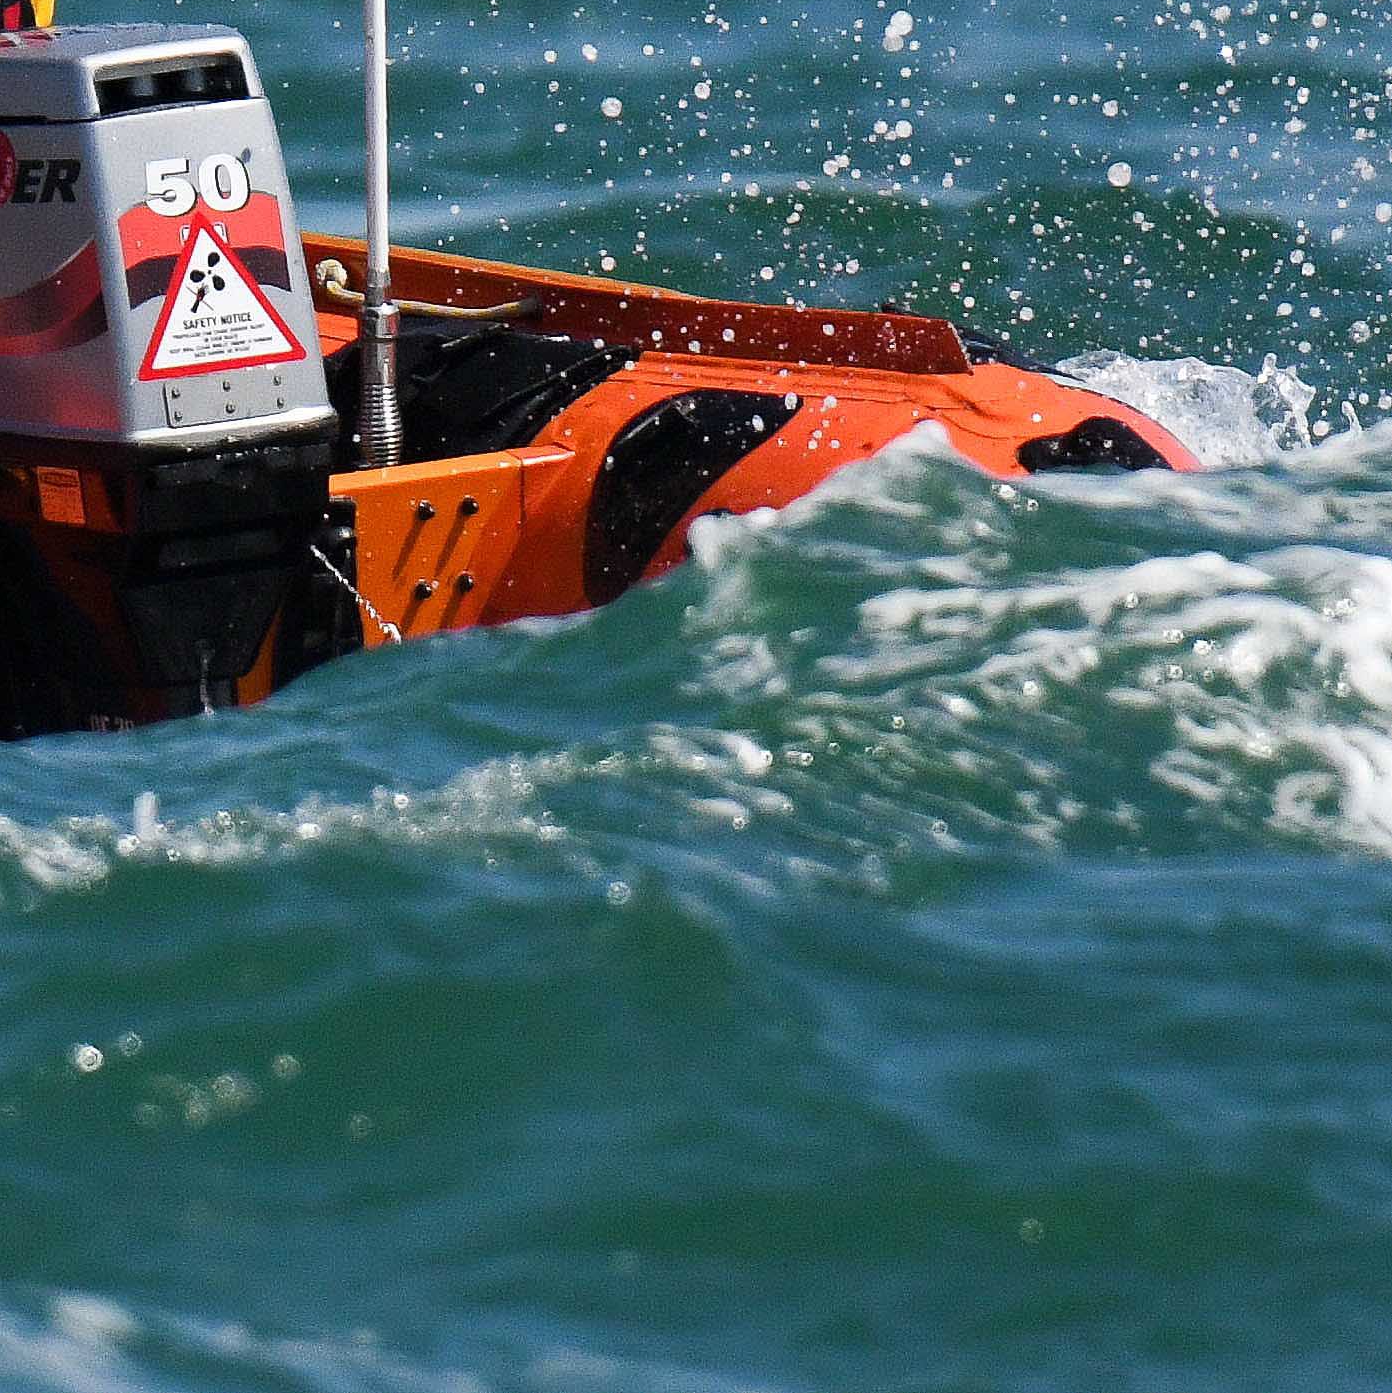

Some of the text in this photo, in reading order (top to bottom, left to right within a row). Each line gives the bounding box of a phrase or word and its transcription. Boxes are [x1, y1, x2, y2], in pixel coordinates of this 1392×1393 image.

[145, 153, 250, 218] 50
[182, 311, 253, 330] SAFETY NOTICE
